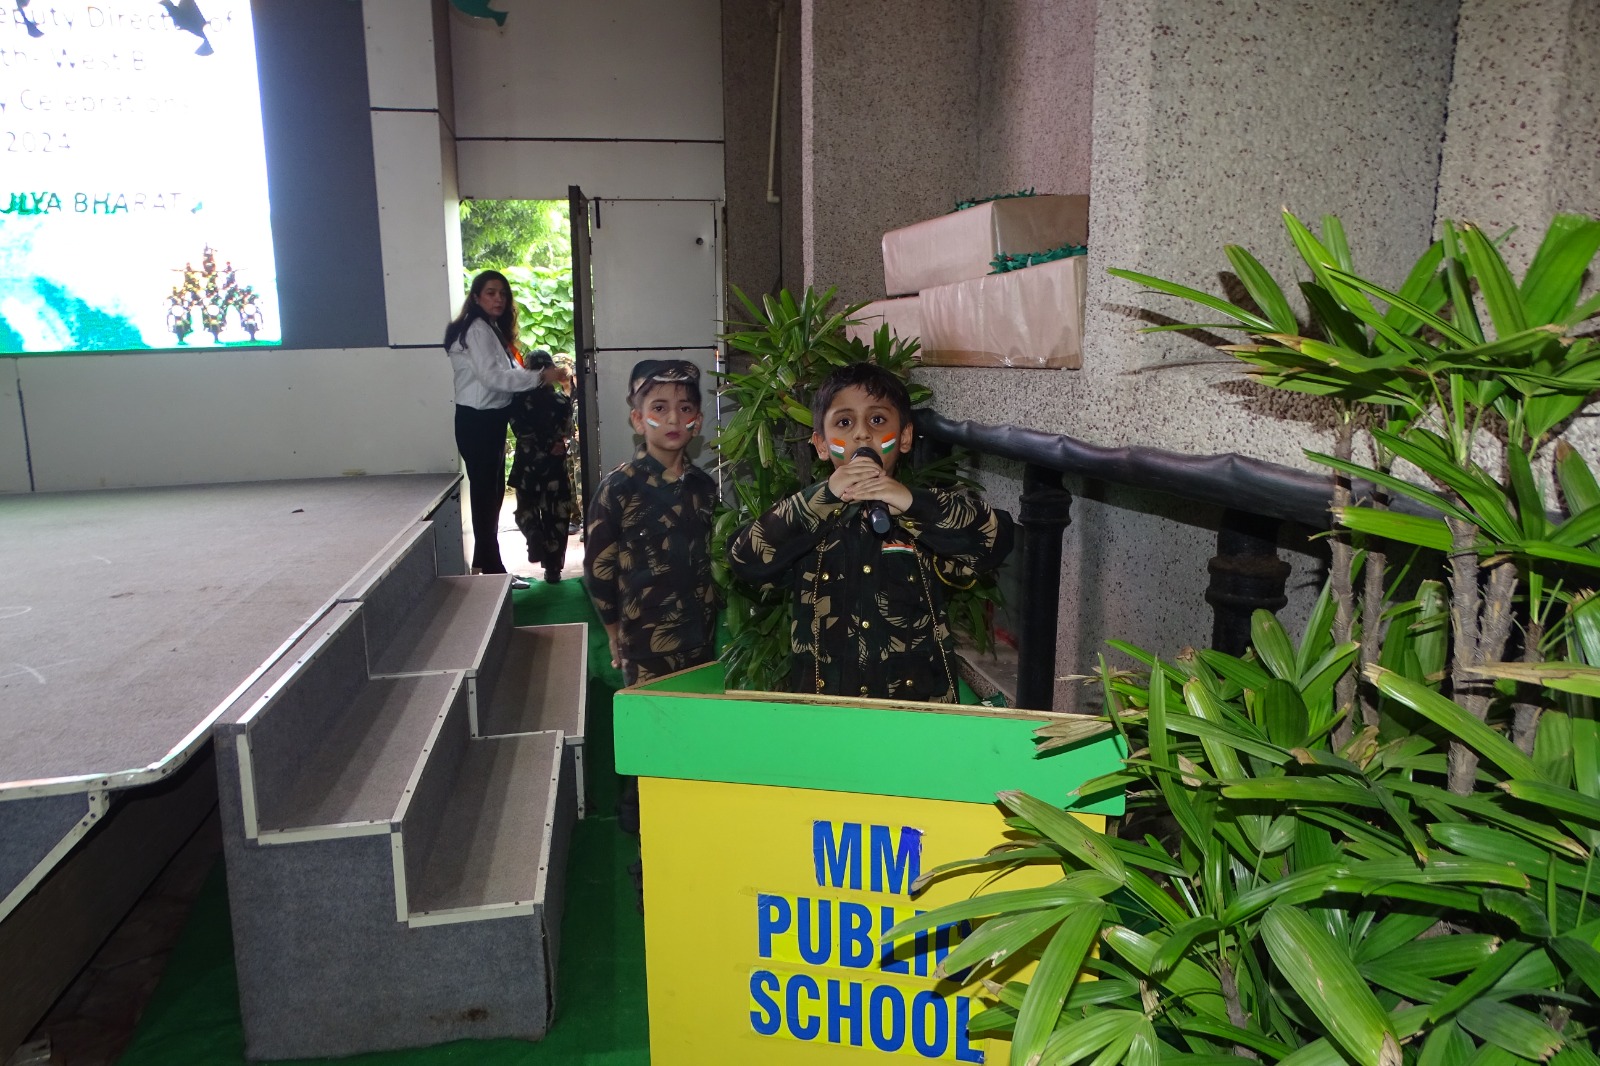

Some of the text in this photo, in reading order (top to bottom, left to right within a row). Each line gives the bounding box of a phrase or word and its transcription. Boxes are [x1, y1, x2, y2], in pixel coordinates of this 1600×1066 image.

[87, 5, 182, 31] Direct
[74, 192, 182, 214] BHARAT
[812, 820, 922, 896] MM
[749, 970, 986, 1064] SCHOOL
